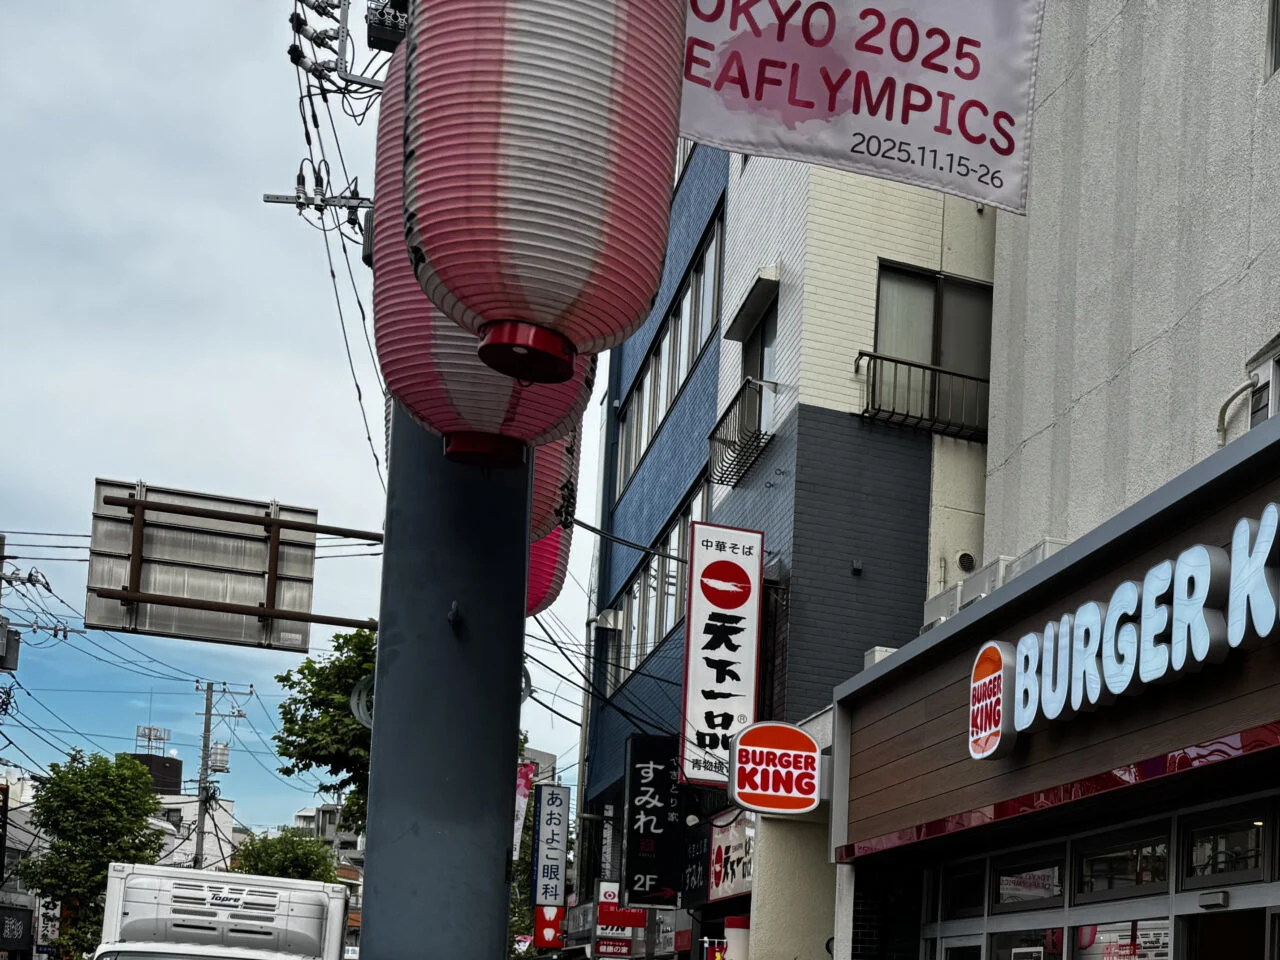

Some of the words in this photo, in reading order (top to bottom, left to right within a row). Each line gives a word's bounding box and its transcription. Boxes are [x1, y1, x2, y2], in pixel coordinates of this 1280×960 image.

[854, 8, 981, 80] 2025
[683, 36, 1015, 156] EAFLYMPICS
[849, 131, 1004, 190] 2025.11.15-26
[701, 538, 754, 557] 中華そば
[1014, 543, 1216, 734] BURGER
[696, 612, 747, 750] 天下一品
[971, 674, 1002, 706] BURGER
[971, 697, 1002, 738] KING
[691, 758, 730, 774] 青物横
[737, 748, 816, 772] BURGER
[633, 760, 664, 834] すみれ
[737, 766, 816, 796] KING
[541, 790, 563, 900] あおよこ眼科
[210, 893, 240, 904] Topre
[633, 874, 658, 892] 2F
